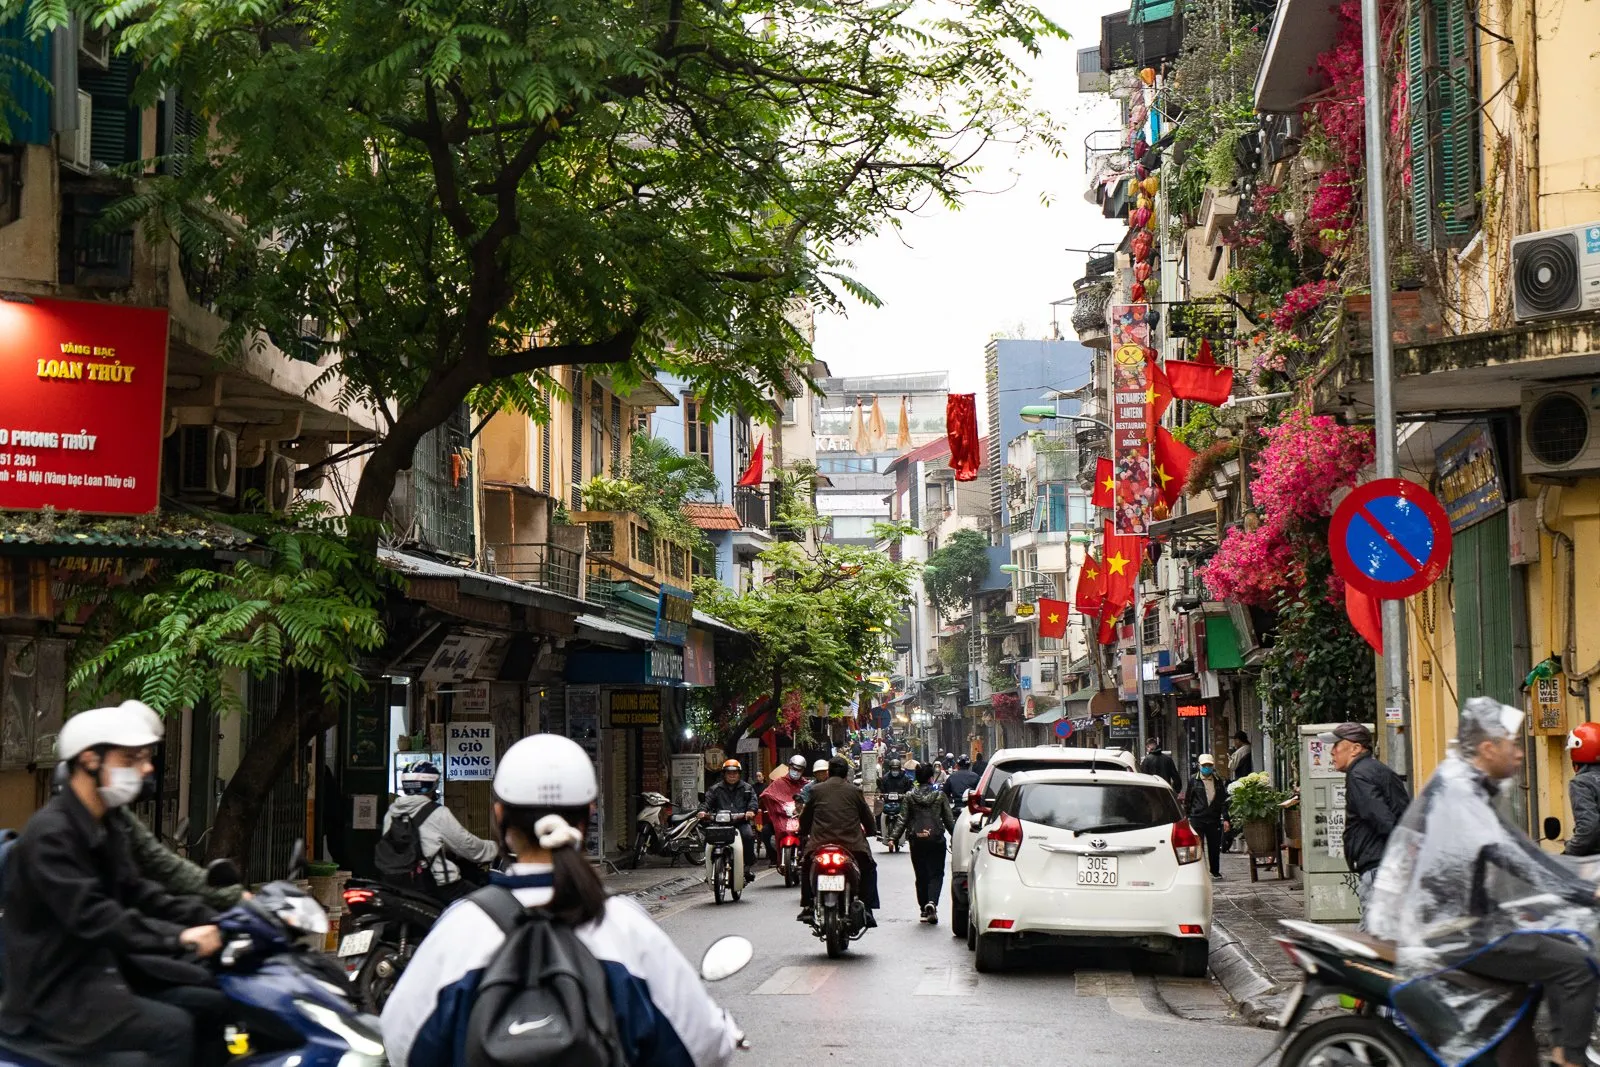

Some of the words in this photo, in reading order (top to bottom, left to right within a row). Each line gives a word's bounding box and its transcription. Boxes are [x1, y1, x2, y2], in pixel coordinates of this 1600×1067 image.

[60, 342, 91, 355] VÀNG
[93, 346, 116, 359] BẠC
[36, 358, 84, 379] LOAN
[87, 360, 136, 383] THỦY
[1120, 407, 1143, 418] LANTERN
[11, 429, 59, 448] PHONG
[61, 429, 97, 451] THỦY
[1127, 430, 1136, 439] &
[1122, 438, 1142, 446] DRINKS
[13, 454, 37, 467] 2641
[16, 470, 27, 482] Hà
[28, 471, 43, 485] Nội
[84, 474, 103, 487] Loan
[1539, 679, 1558, 690] BNE
[611, 693, 638, 710] BOOKING
[639, 692, 660, 710] OFFICE
[631, 713, 660, 724] EXCHANGE
[1111, 714, 1131, 727] Spa
[451, 725, 490, 738] BÁNH
[458, 740, 483, 752] GIÒ
[450, 753, 490, 766] NÓNG
[1087, 857, 1109, 871] 30E
[1078, 870, 1116, 884] 603.20
